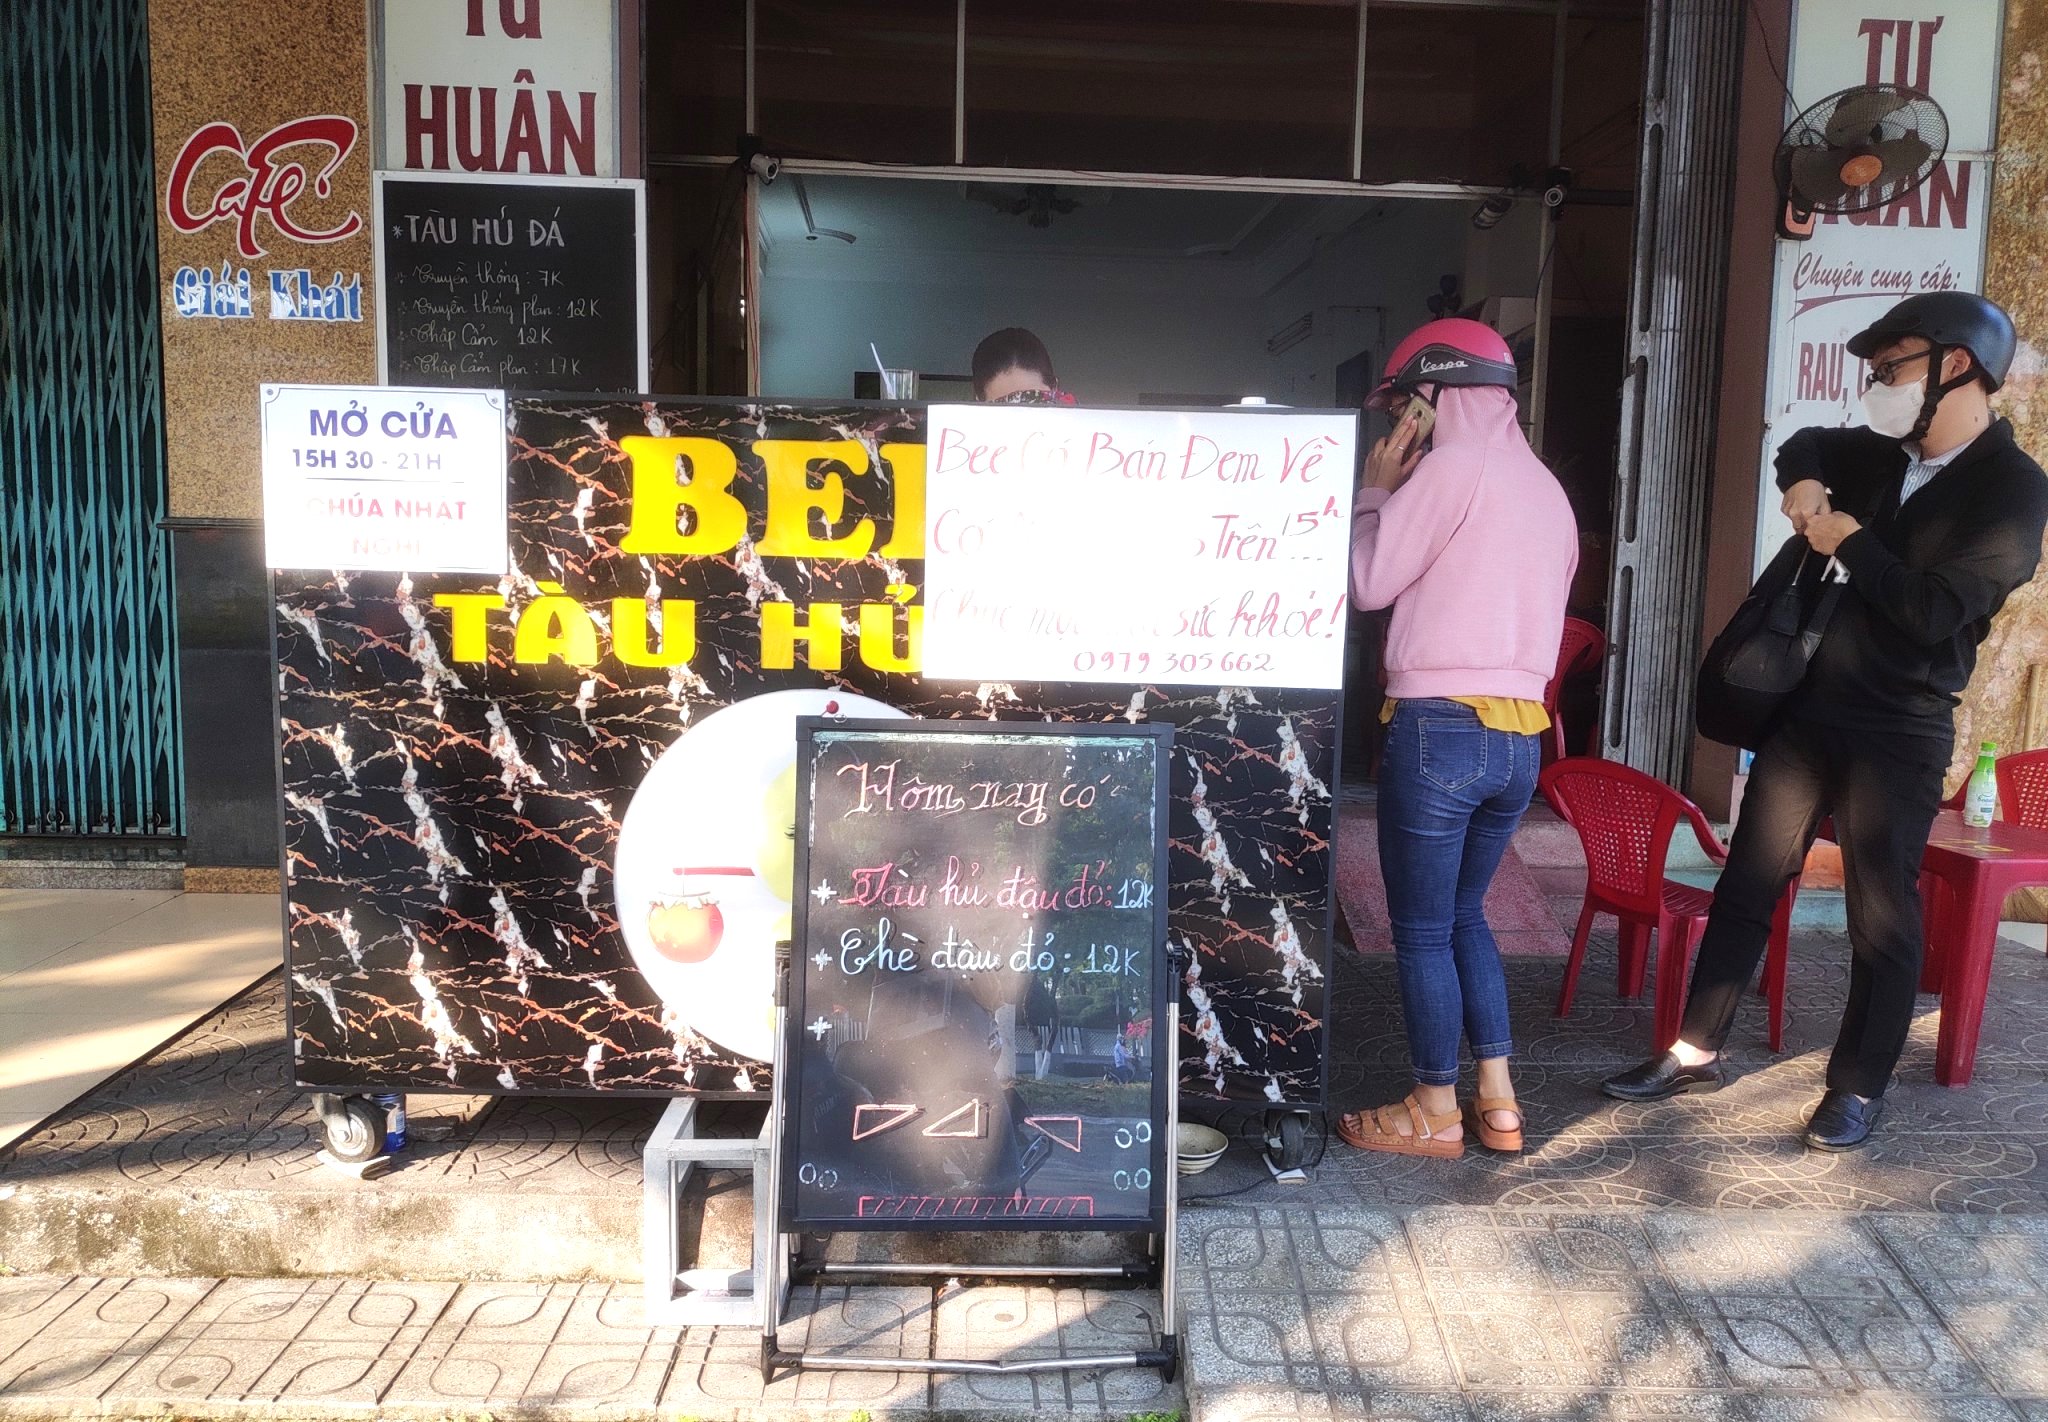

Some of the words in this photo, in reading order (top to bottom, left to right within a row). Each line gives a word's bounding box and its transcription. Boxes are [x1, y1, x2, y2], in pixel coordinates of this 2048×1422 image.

[403, 68, 597, 176] HUÂN
[404, 209, 457, 244] TÀU
[526, 206, 565, 247] ĐÁ
[173, 259, 254, 319] Giải
[268, 269, 364, 322] Khát
[538, 270, 565, 286] 7K
[1793, 252, 1865, 295] Chuyên
[1871, 268, 1913, 299] cung
[566, 298, 601, 319] 12K
[517, 327, 552, 345] 12K
[546, 358, 582, 376] 17K
[1420, 356, 1468, 374] Vespa
[1797, 342, 1848, 409] RAU,
[309, 400, 369, 437] MỞ
[381, 401, 458, 439] CỬA
[292, 449, 337, 469] 15H
[344, 450, 374, 470] 30
[397, 452, 442, 470] 21H
[936, 427, 1008, 475] Bee
[1087, 431, 1167, 481] Bán
[1179, 434, 1265, 484] Đem
[1280, 435, 1341, 484] Về
[1212, 514, 1278, 562] Trên
[433, 581, 696, 669] TÀU
[1073, 651, 1150, 675] 0979
[837, 759, 966, 818] Hôm
[970, 781, 1050, 826] nay
[1060, 774, 1111, 809] có
[839, 862, 927, 907] Tàu
[940, 855, 986, 907] hủ
[998, 865, 1060, 918] đậu
[1114, 878, 1153, 909] 12K
[840, 917, 918, 974] Chè
[932, 926, 1000, 980] đậu
[1082, 943, 1141, 976] 12K
